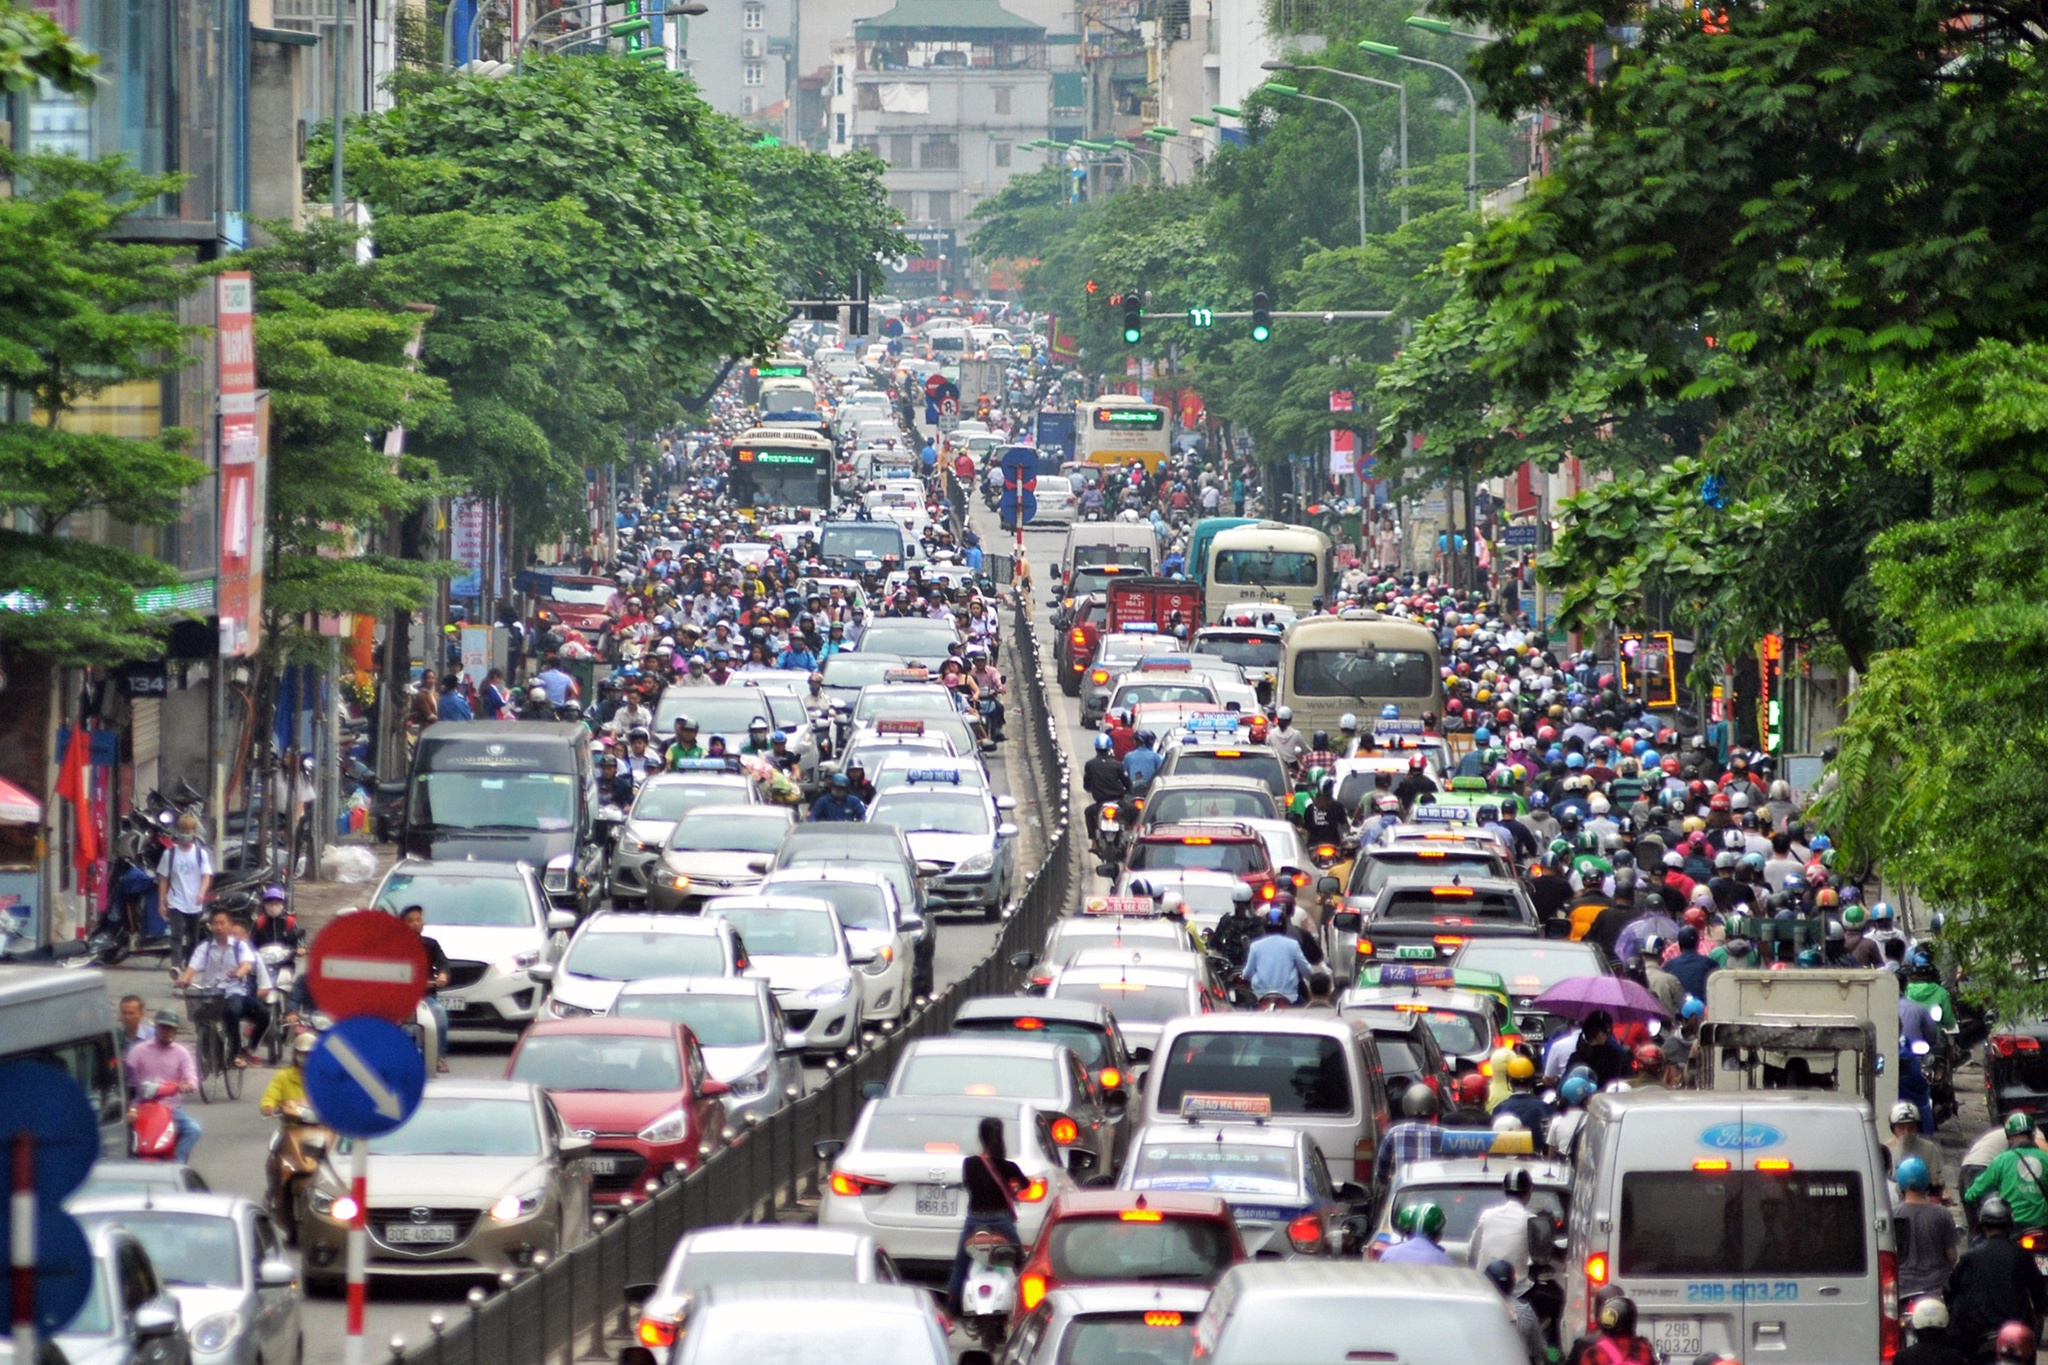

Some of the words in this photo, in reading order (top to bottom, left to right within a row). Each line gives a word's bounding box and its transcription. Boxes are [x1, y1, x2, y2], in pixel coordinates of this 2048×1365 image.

[128, 677, 164, 691] 134
[1405, 949, 1429, 958] TAXI
[1716, 1125, 1765, 1147] Ford
[1687, 1281, 1798, 1301] 29B-603.20
[1665, 1323, 1690, 1338] 29B
[1656, 1339, 1699, 1353] 603.20
